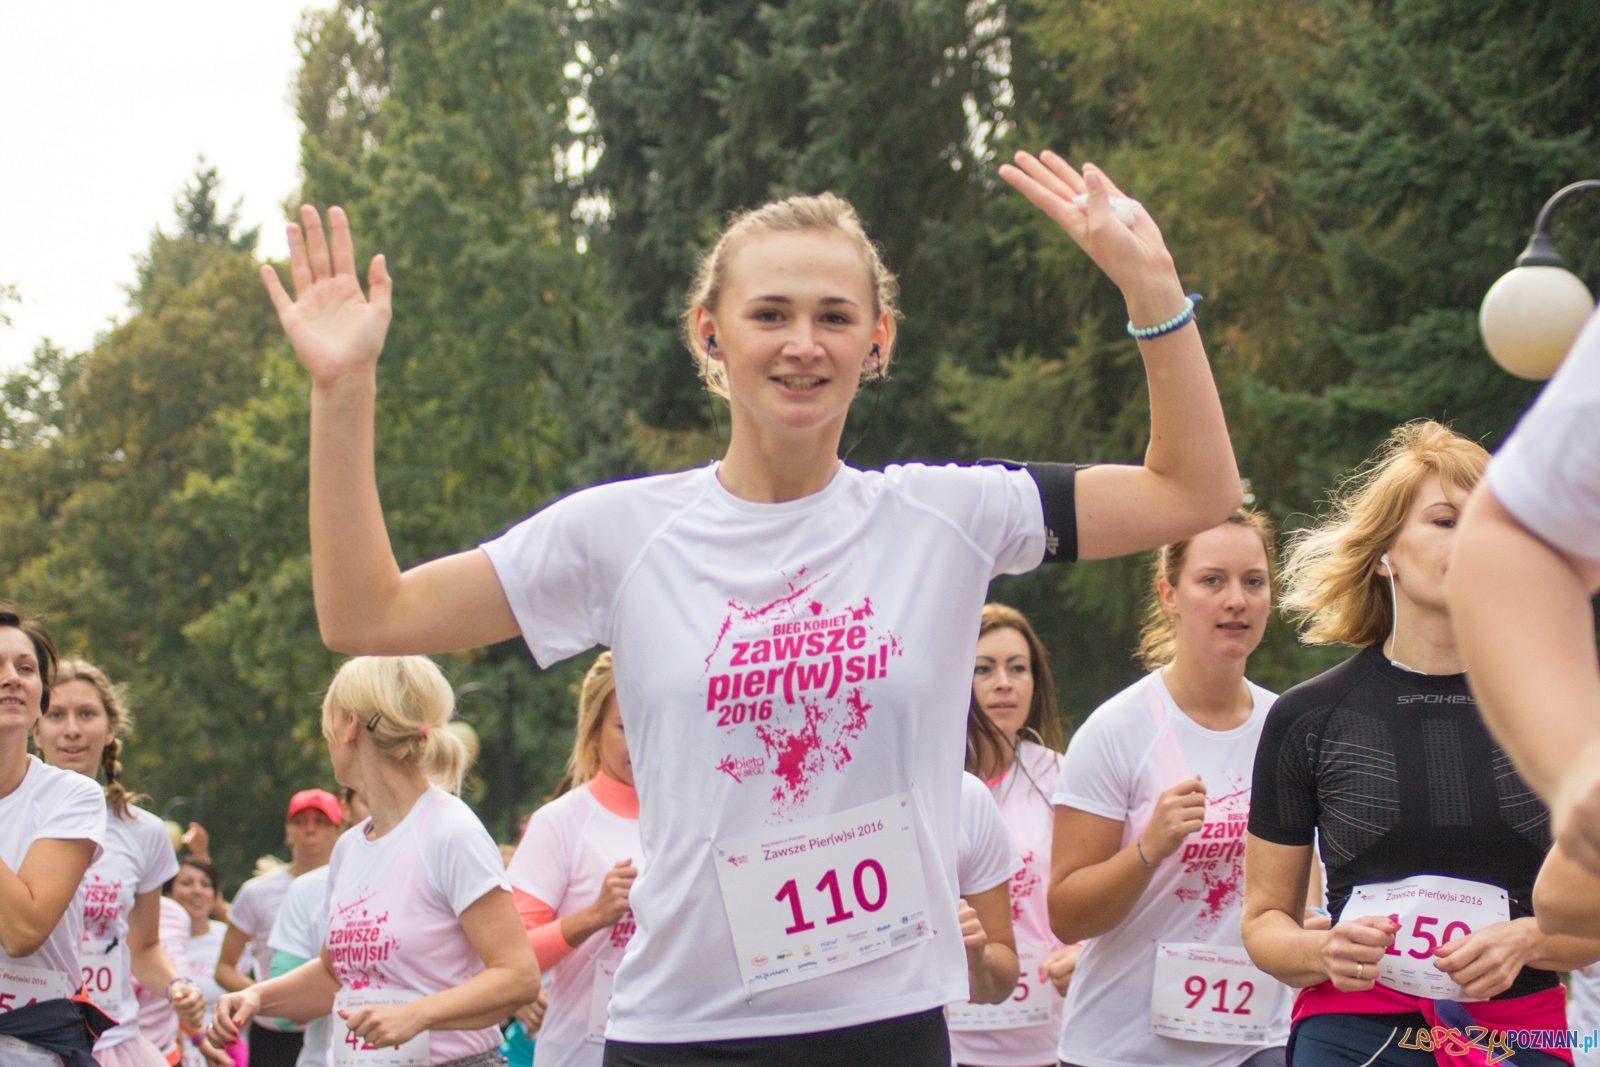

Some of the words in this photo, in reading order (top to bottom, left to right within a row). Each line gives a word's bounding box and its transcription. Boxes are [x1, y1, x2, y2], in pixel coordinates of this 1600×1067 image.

[773, 622, 801, 636] BIEG
[804, 615, 848, 631] KOBIET
[729, 624, 867, 667] zawsze
[706, 644, 889, 712] pier(w)si!
[717, 700, 773, 727] 2016
[763, 843, 807, 861] Zawsze
[808, 828, 856, 850] Pier(w)si
[857, 820, 884, 837] 2016
[1201, 822, 1247, 839] zaw
[775, 858, 888, 935] 110
[1385, 890, 1416, 901] Zawsze
[1418, 888, 1457, 903] Pier(w)si
[1459, 894, 1483, 906] 2016
[329, 927, 380, 945] zawsze
[1184, 975, 1254, 1015] 912
